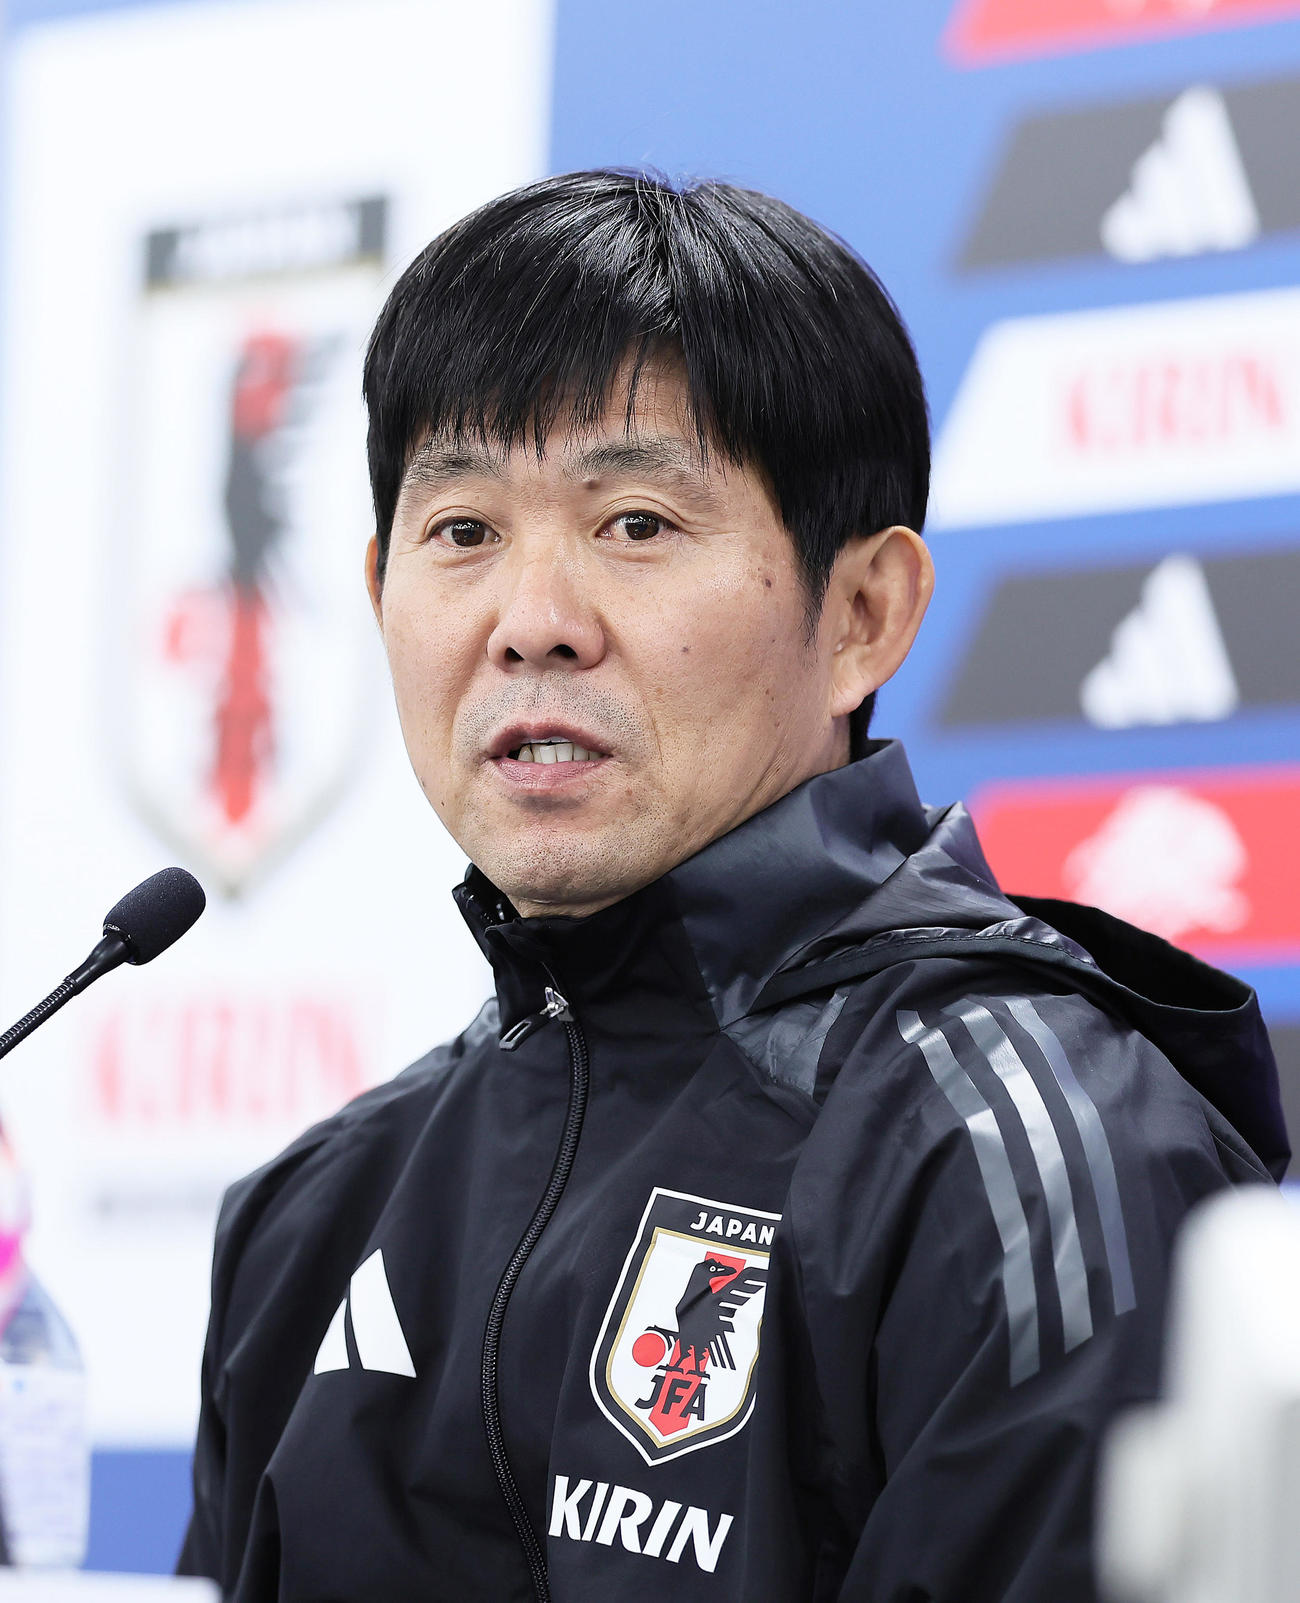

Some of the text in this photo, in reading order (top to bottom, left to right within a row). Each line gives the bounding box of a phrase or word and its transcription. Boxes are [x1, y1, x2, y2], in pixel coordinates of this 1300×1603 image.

[690, 1211, 775, 1246] JAPAN
[634, 1375, 707, 1421] JFA
[548, 1474, 735, 1573] KIRIN
